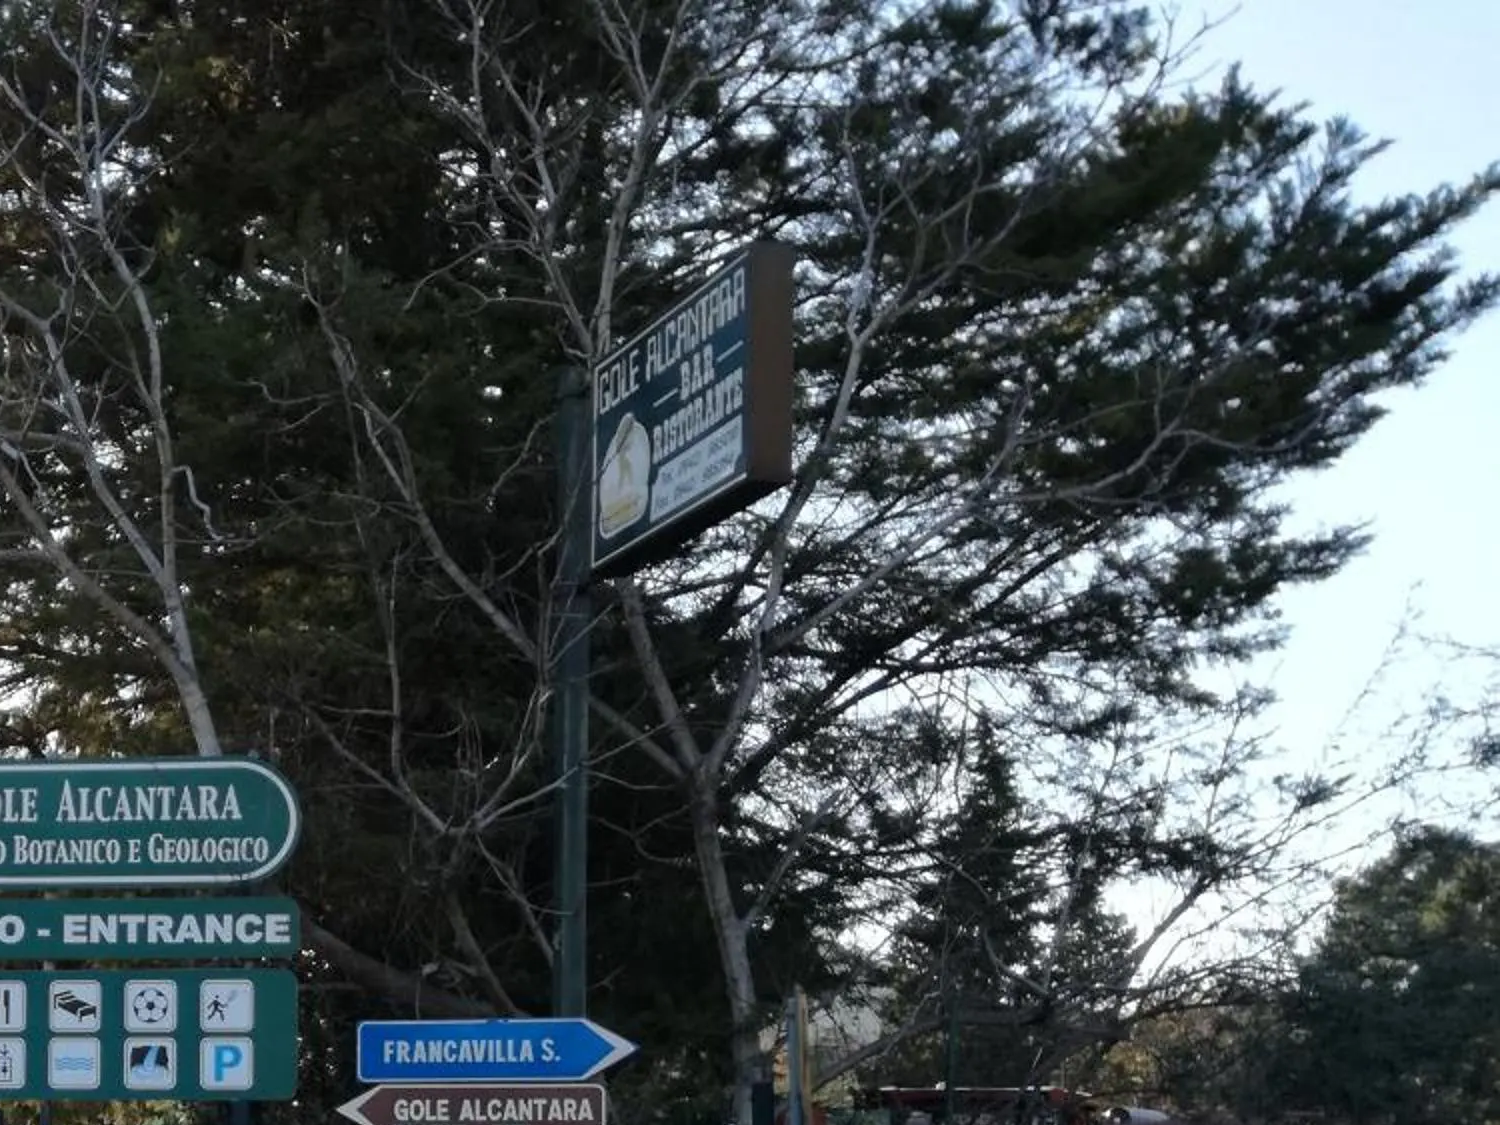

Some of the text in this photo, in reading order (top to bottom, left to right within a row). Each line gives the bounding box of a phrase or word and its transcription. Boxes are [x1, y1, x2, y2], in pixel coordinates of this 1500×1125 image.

[599, 266, 746, 415] GOLE ALCANTARA
[680, 344, 715, 400] BAR
[652, 367, 743, 465] RISTORANTE
[55, 778, 243, 823] ALCANTARA
[13, 834, 120, 865] BOTANICO
[127, 838, 141, 863] E
[148, 833, 268, 864] GEOLOGICO
[63, 914, 291, 945] ENTRANCE
[214, 1045, 242, 1081] P
[383, 1039, 561, 1064] FRANCAVILLA S.
[394, 1098, 594, 1121] GOLE ALCANTARA
